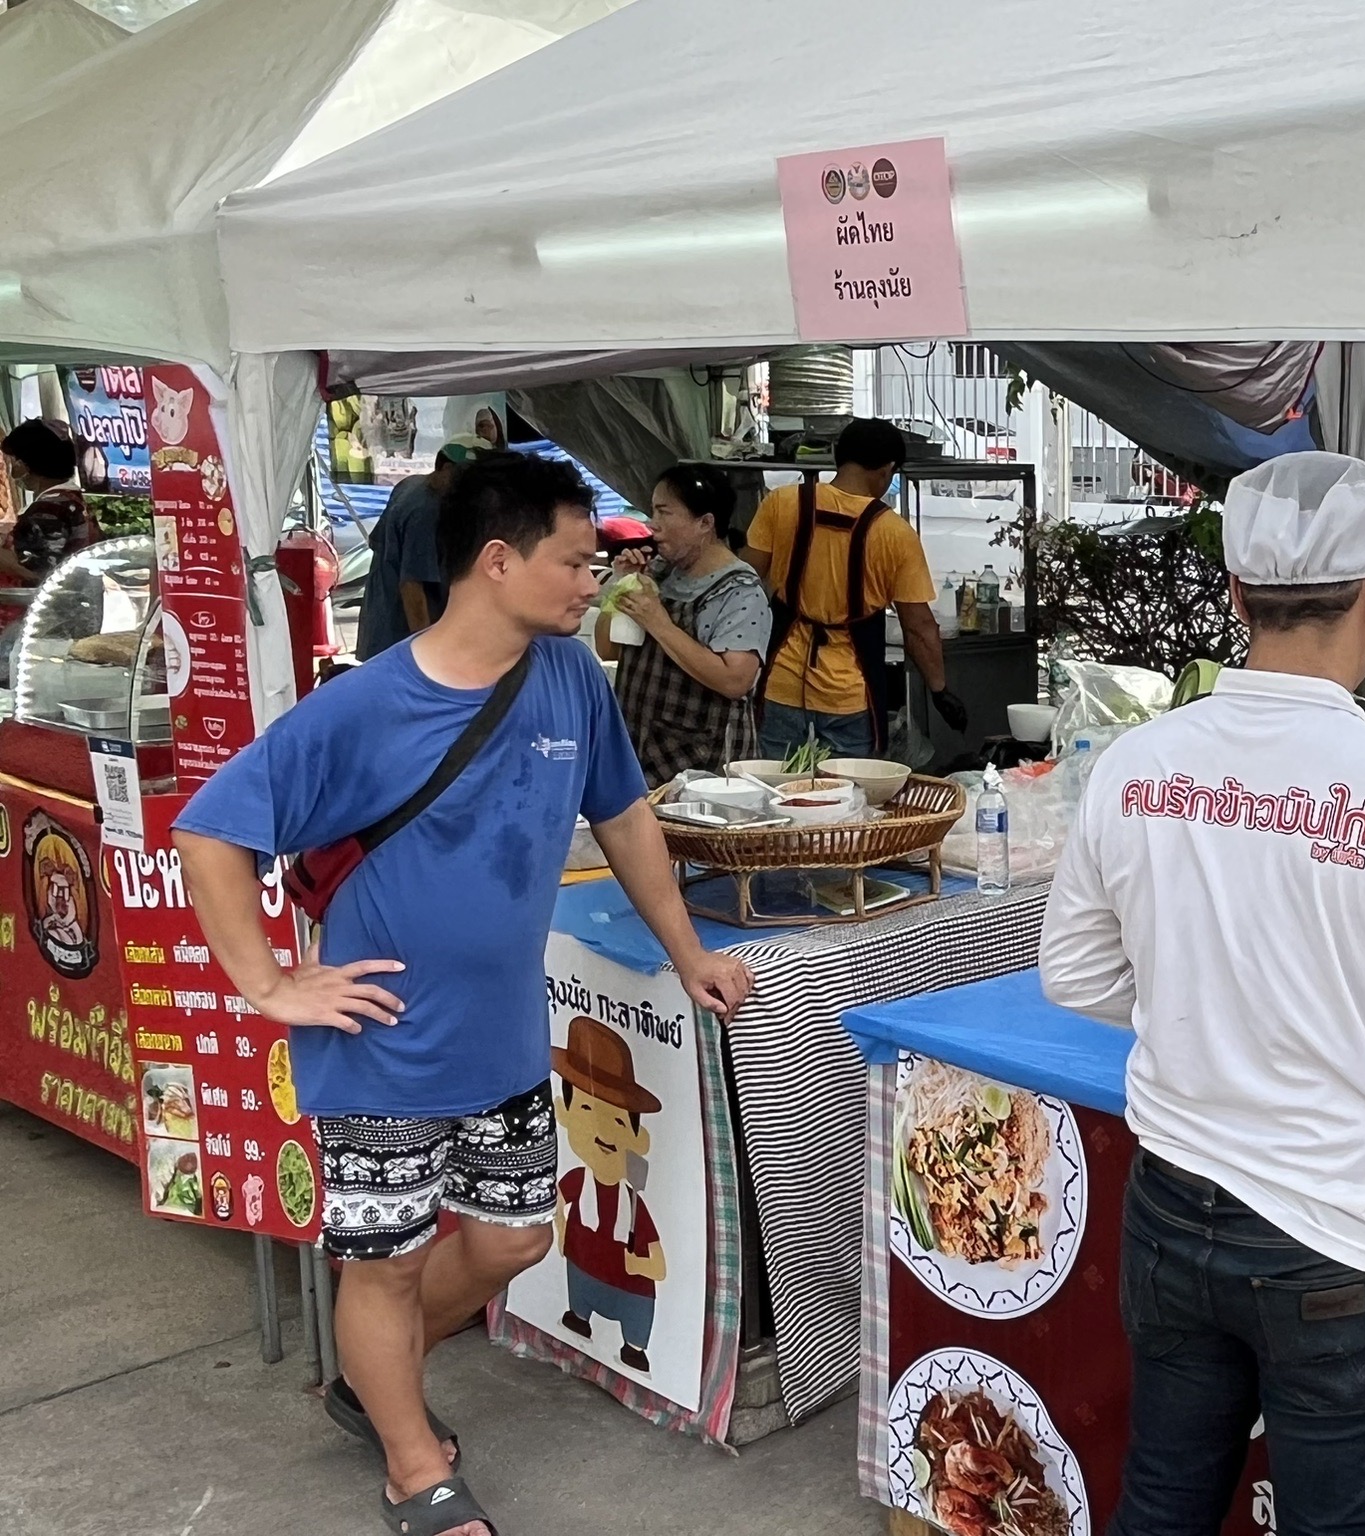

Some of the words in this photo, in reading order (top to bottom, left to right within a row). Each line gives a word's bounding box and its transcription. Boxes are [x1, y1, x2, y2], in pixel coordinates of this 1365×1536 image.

[873, 170, 895, 182] OTOP
[836, 211, 894, 245] ผัดไทย
[834, 267, 912, 309] ร้านลุงนัย
[79, 406, 147, 458] ปลาทูโป
[597, 994, 686, 1050] กะลาทิพย์
[235, 1035, 257, 1058] 39.-
[241, 1088, 262, 1111] 59.-
